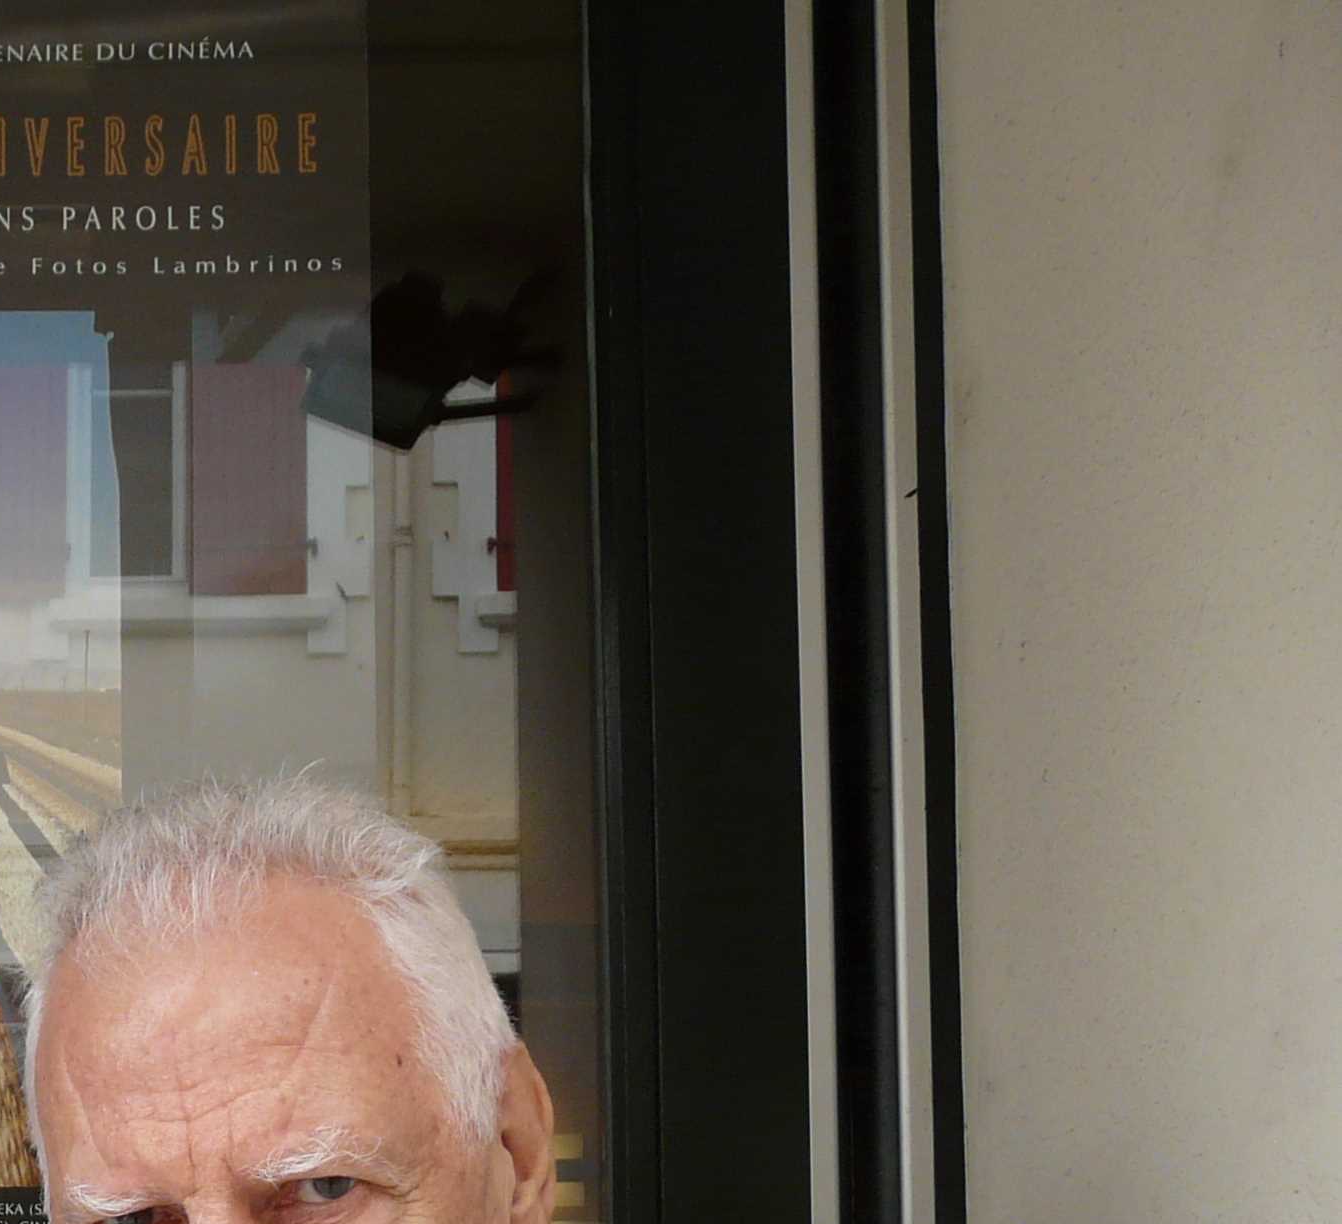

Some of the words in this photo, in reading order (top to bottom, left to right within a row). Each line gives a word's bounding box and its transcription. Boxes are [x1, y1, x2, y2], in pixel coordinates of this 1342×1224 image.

[96, 42, 136, 62] DU
[148, 37, 255, 61] CINÉMA
[61, 204, 226, 231] PAROLES
[30, 256, 128, 276] Fotos
[153, 254, 344, 275] Lambrinos
